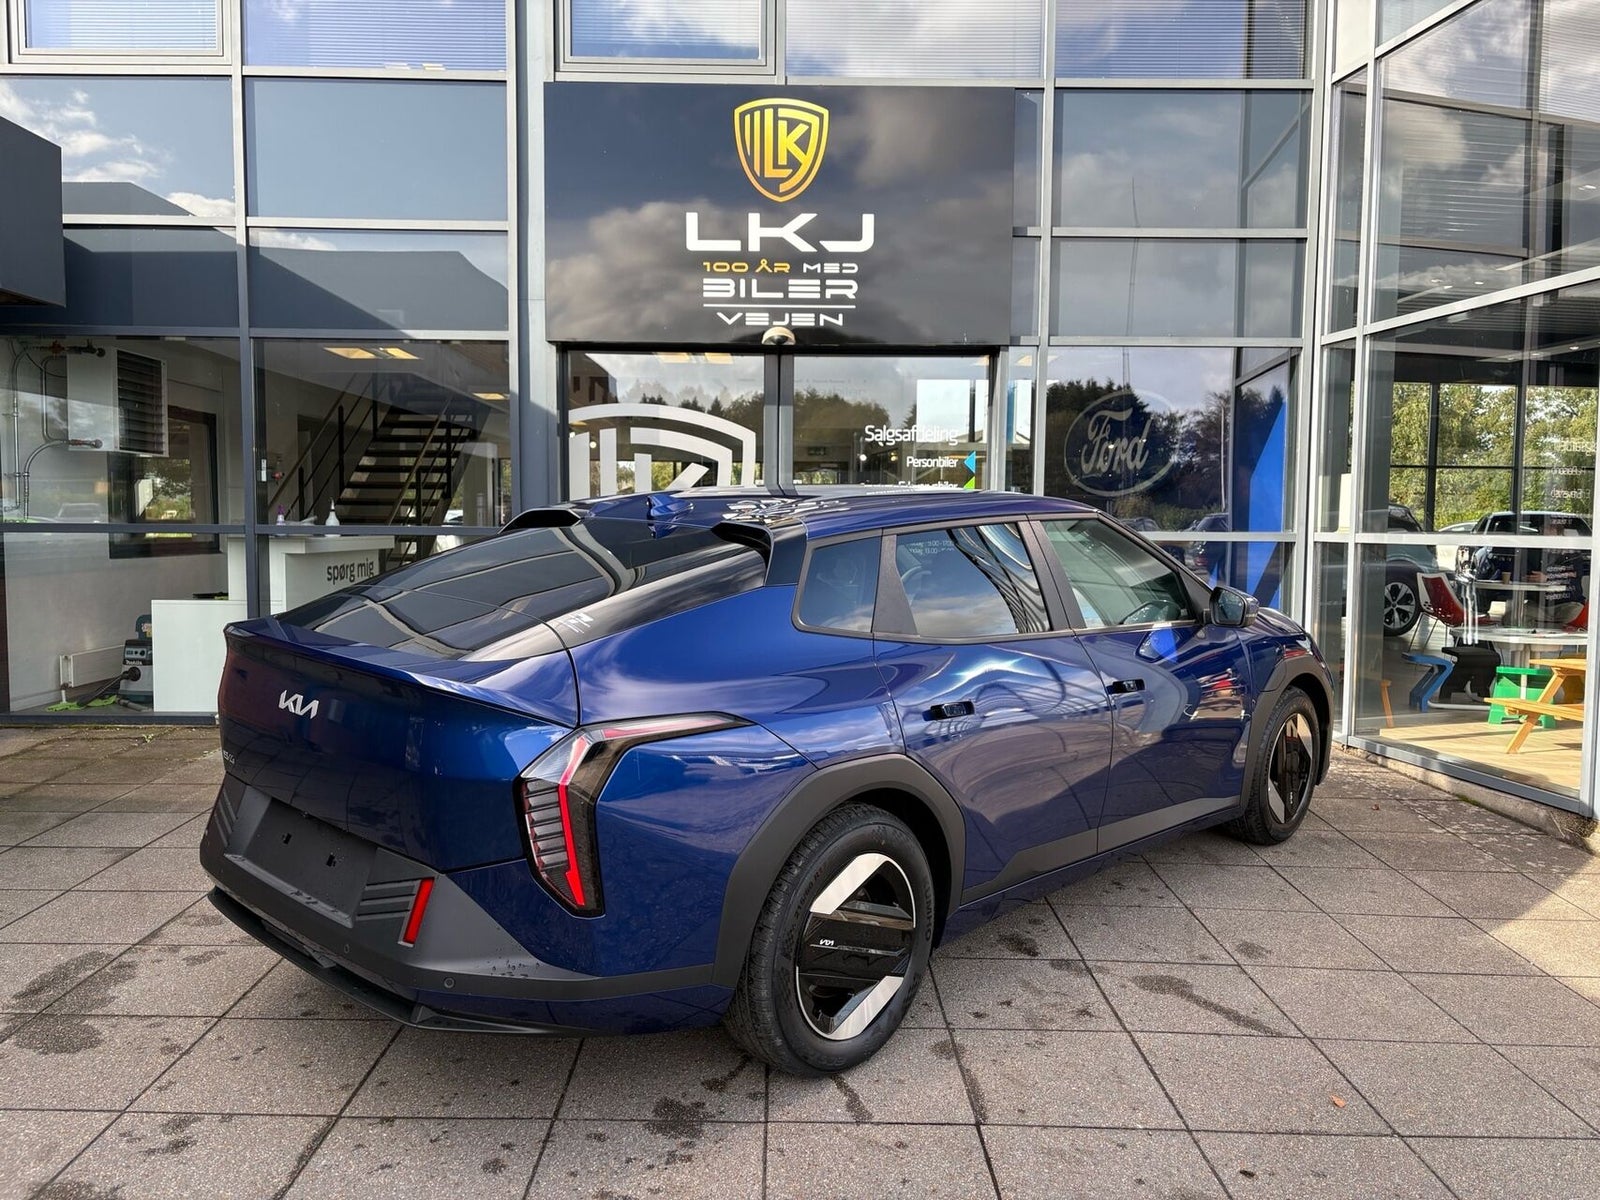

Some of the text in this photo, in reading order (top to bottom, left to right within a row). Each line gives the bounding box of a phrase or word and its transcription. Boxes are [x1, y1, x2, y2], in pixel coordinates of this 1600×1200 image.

[685, 212, 875, 253] LKJ
[703, 258, 859, 274] 100 ÅR MED
[703, 278, 859, 299] BILER
[716, 312, 843, 327] VEJEN
[1081, 408, 1152, 475] Ford
[906, 456, 959, 468] Personbiler
[326, 557, 374, 586] spørg mig
[278, 689, 321, 719] KIA
